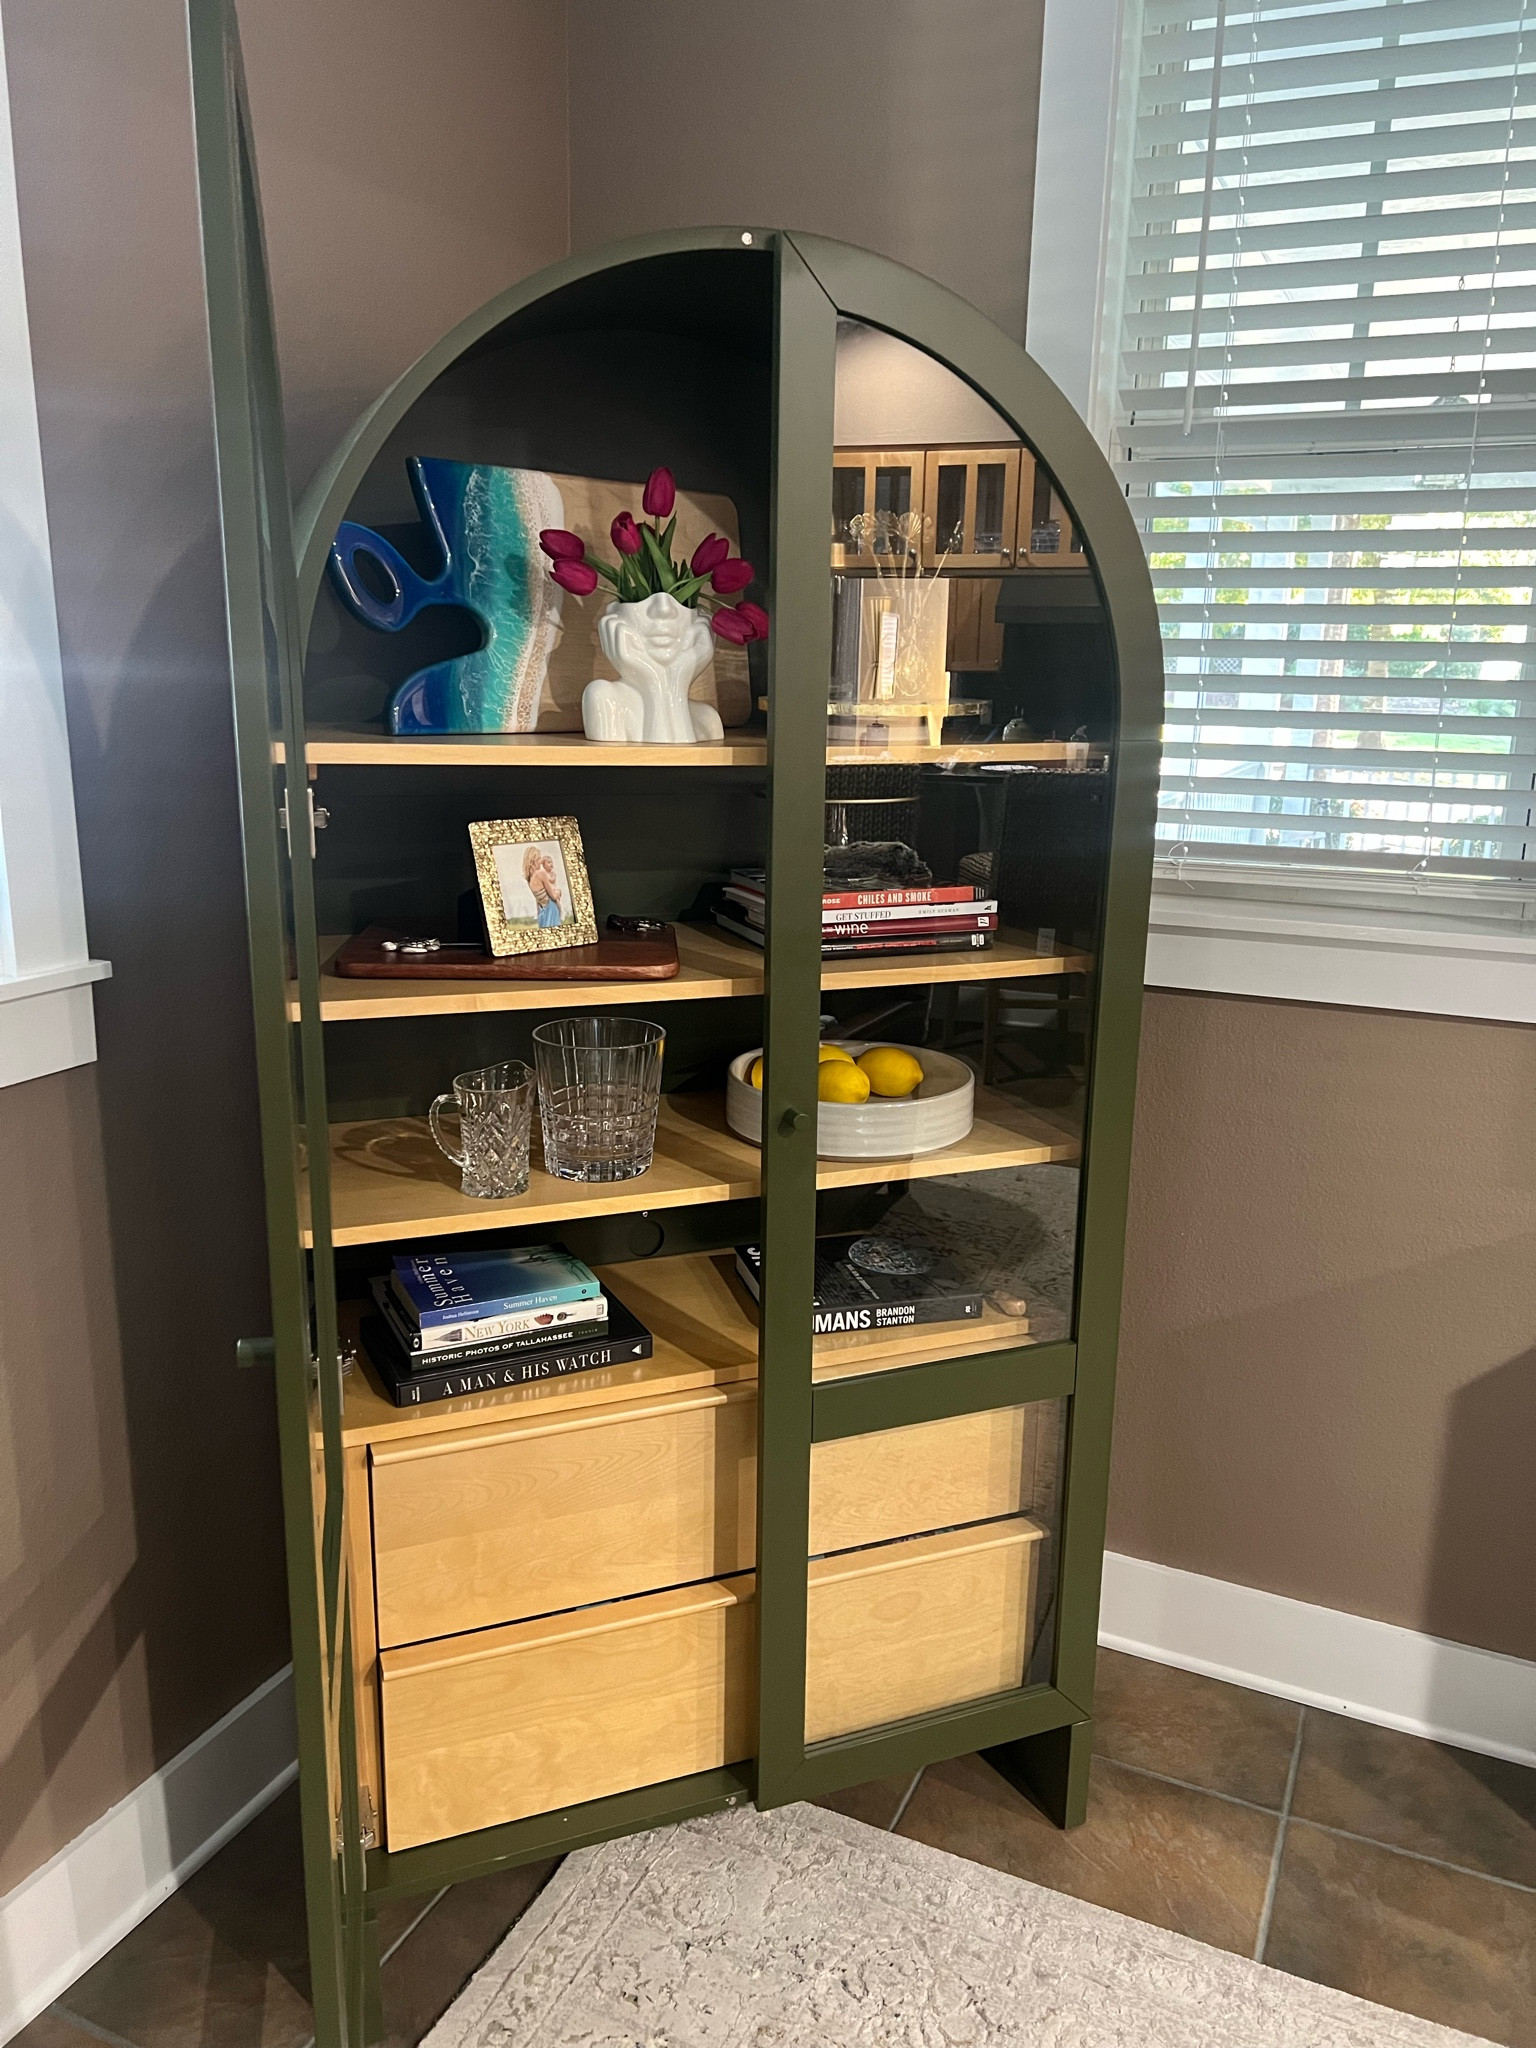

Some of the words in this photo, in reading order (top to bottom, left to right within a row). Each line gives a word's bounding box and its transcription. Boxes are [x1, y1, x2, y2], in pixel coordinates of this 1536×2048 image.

[857, 892, 885, 905] CHILES
[888, 892, 903, 904] AND
[905, 891, 932, 903] SMOKE
[836, 912, 853, 922] GET
[855, 910, 892, 921] STUFFED
[834, 923, 869, 935] wine
[415, 1258, 453, 1307] Summer
[434, 1257, 473, 1304] Haven
[503, 1300, 533, 1310] Summer
[535, 1295, 558, 1304] Haven
[876, 1305, 915, 1318] BRANDON
[813, 1309, 871, 1334] MANS
[876, 1315, 915, 1327] STANTON
[422, 1351, 463, 1365] HISTORIC
[465, 1345, 500, 1357] PHOTOS
[502, 1342, 514, 1350] OF
[516, 1331, 574, 1347] TALLAHASSEE
[442, 1381, 453, 1396] A
[460, 1371, 496, 1392] MAN
[503, 1369, 515, 1383] &
[522, 1361, 550, 1380] HIS
[556, 1349, 611, 1371] WATCH
